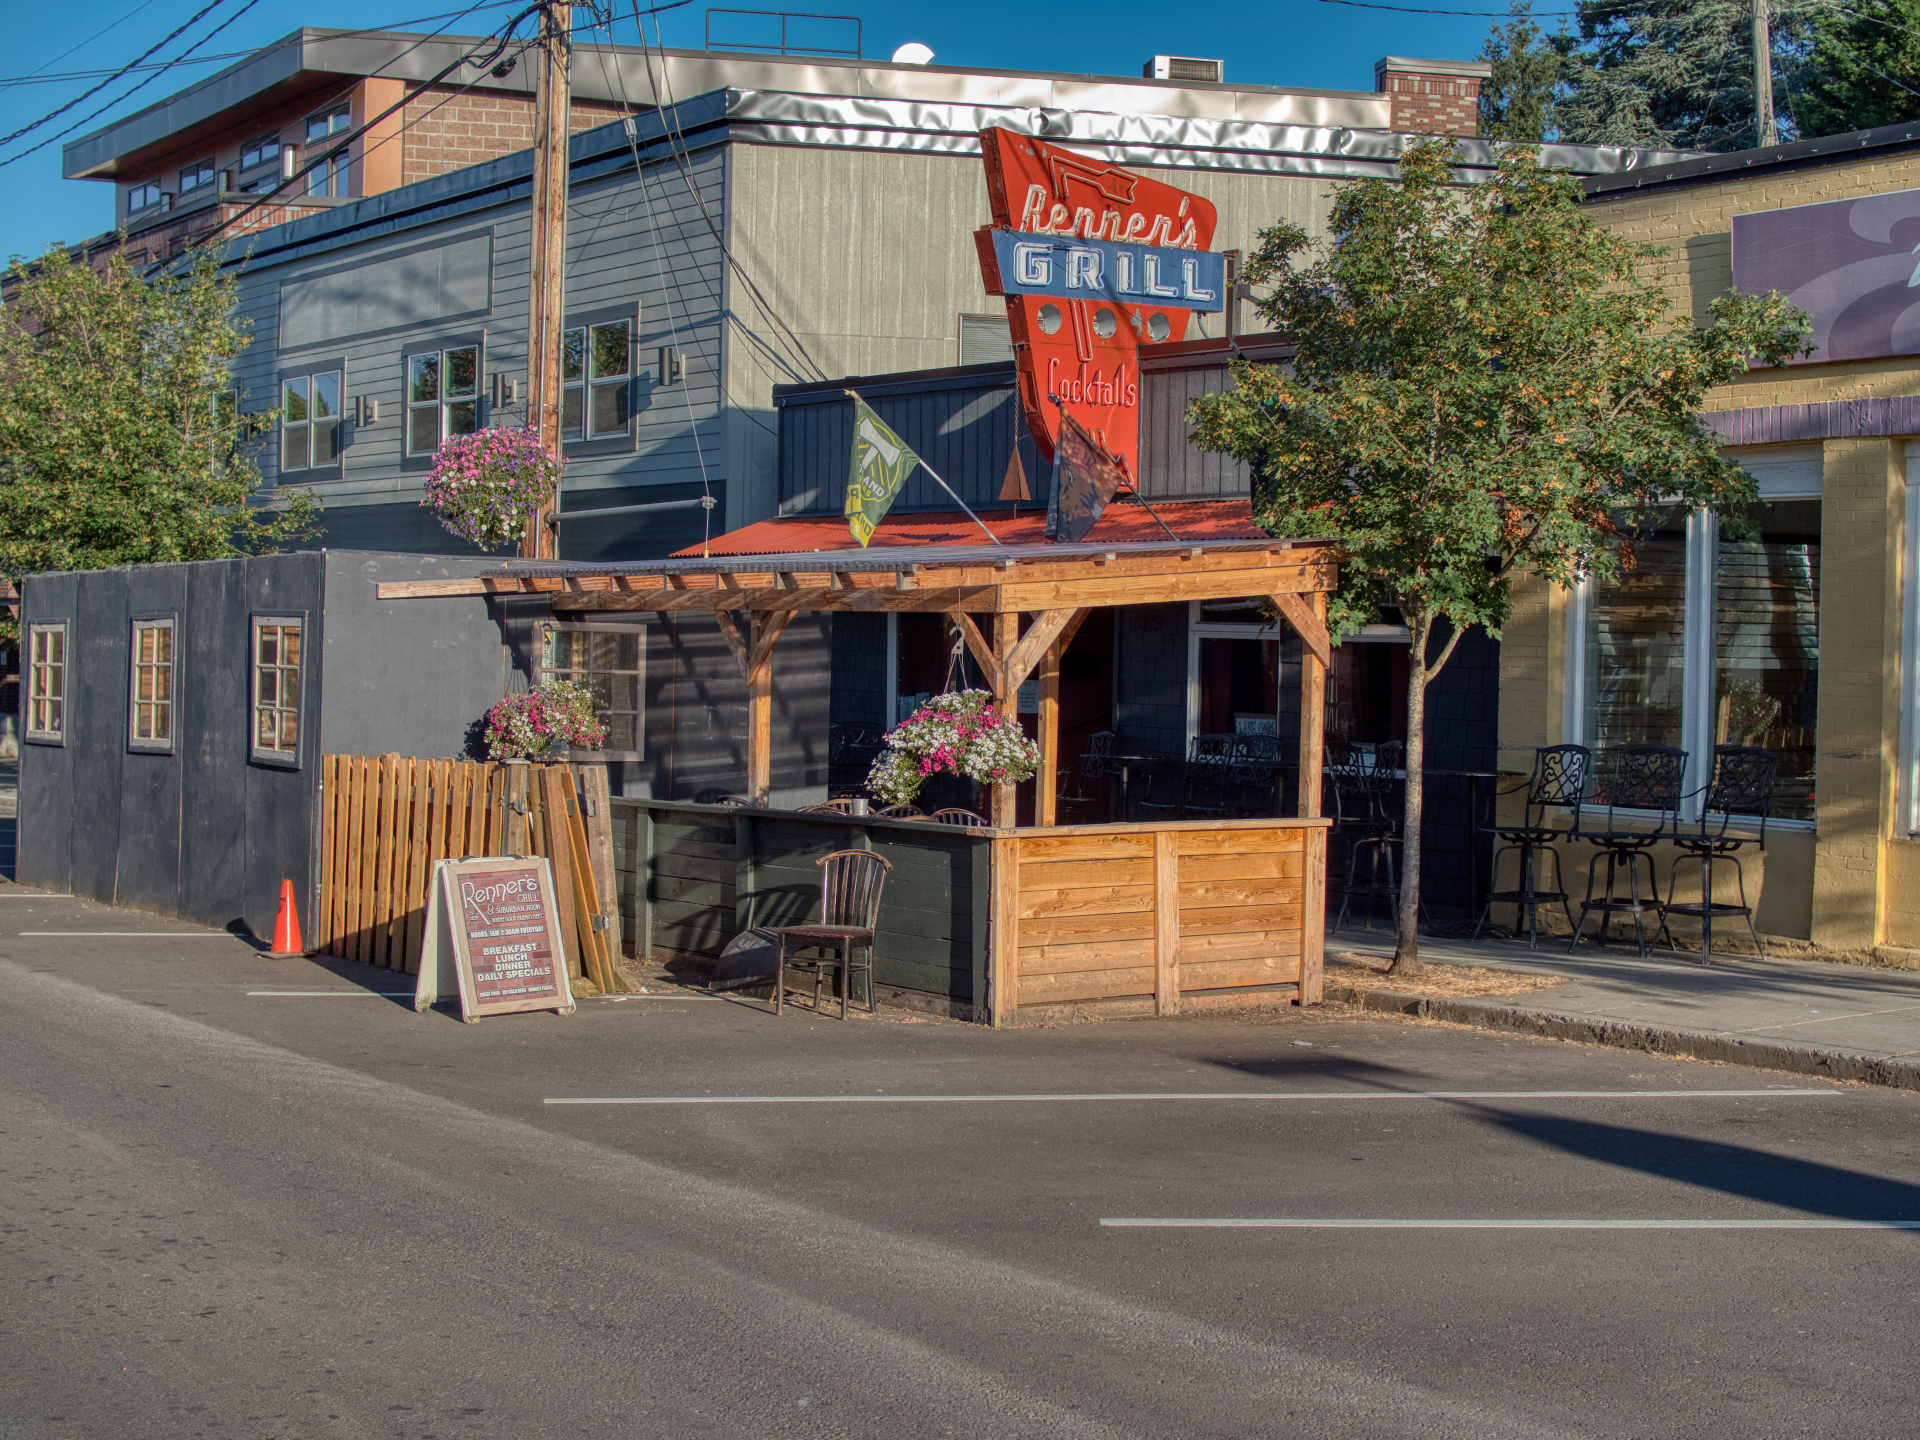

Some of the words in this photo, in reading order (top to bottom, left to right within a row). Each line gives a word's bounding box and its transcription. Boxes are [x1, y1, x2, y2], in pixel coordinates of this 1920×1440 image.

[1020, 184, 1197, 250] Renner's
[1013, 241, 1216, 302] GRILL
[1049, 358, 1136, 406] Cocktails
[461, 874, 538, 926] Renner's
[517, 893, 540, 903] GRILL
[487, 903, 495, 916] &
[495, 905, 525, 914] SUBURBAN
[526, 903, 541, 912] ROOM
[520, 925, 544, 934] EVERYDAY
[483, 943, 537, 955] BREAKFAST
[496, 952, 527, 962] LUNCH
[495, 961, 531, 971] DINNER
[477, 971, 503, 982] DAILY
[506, 967, 551, 979] SPECIALS
